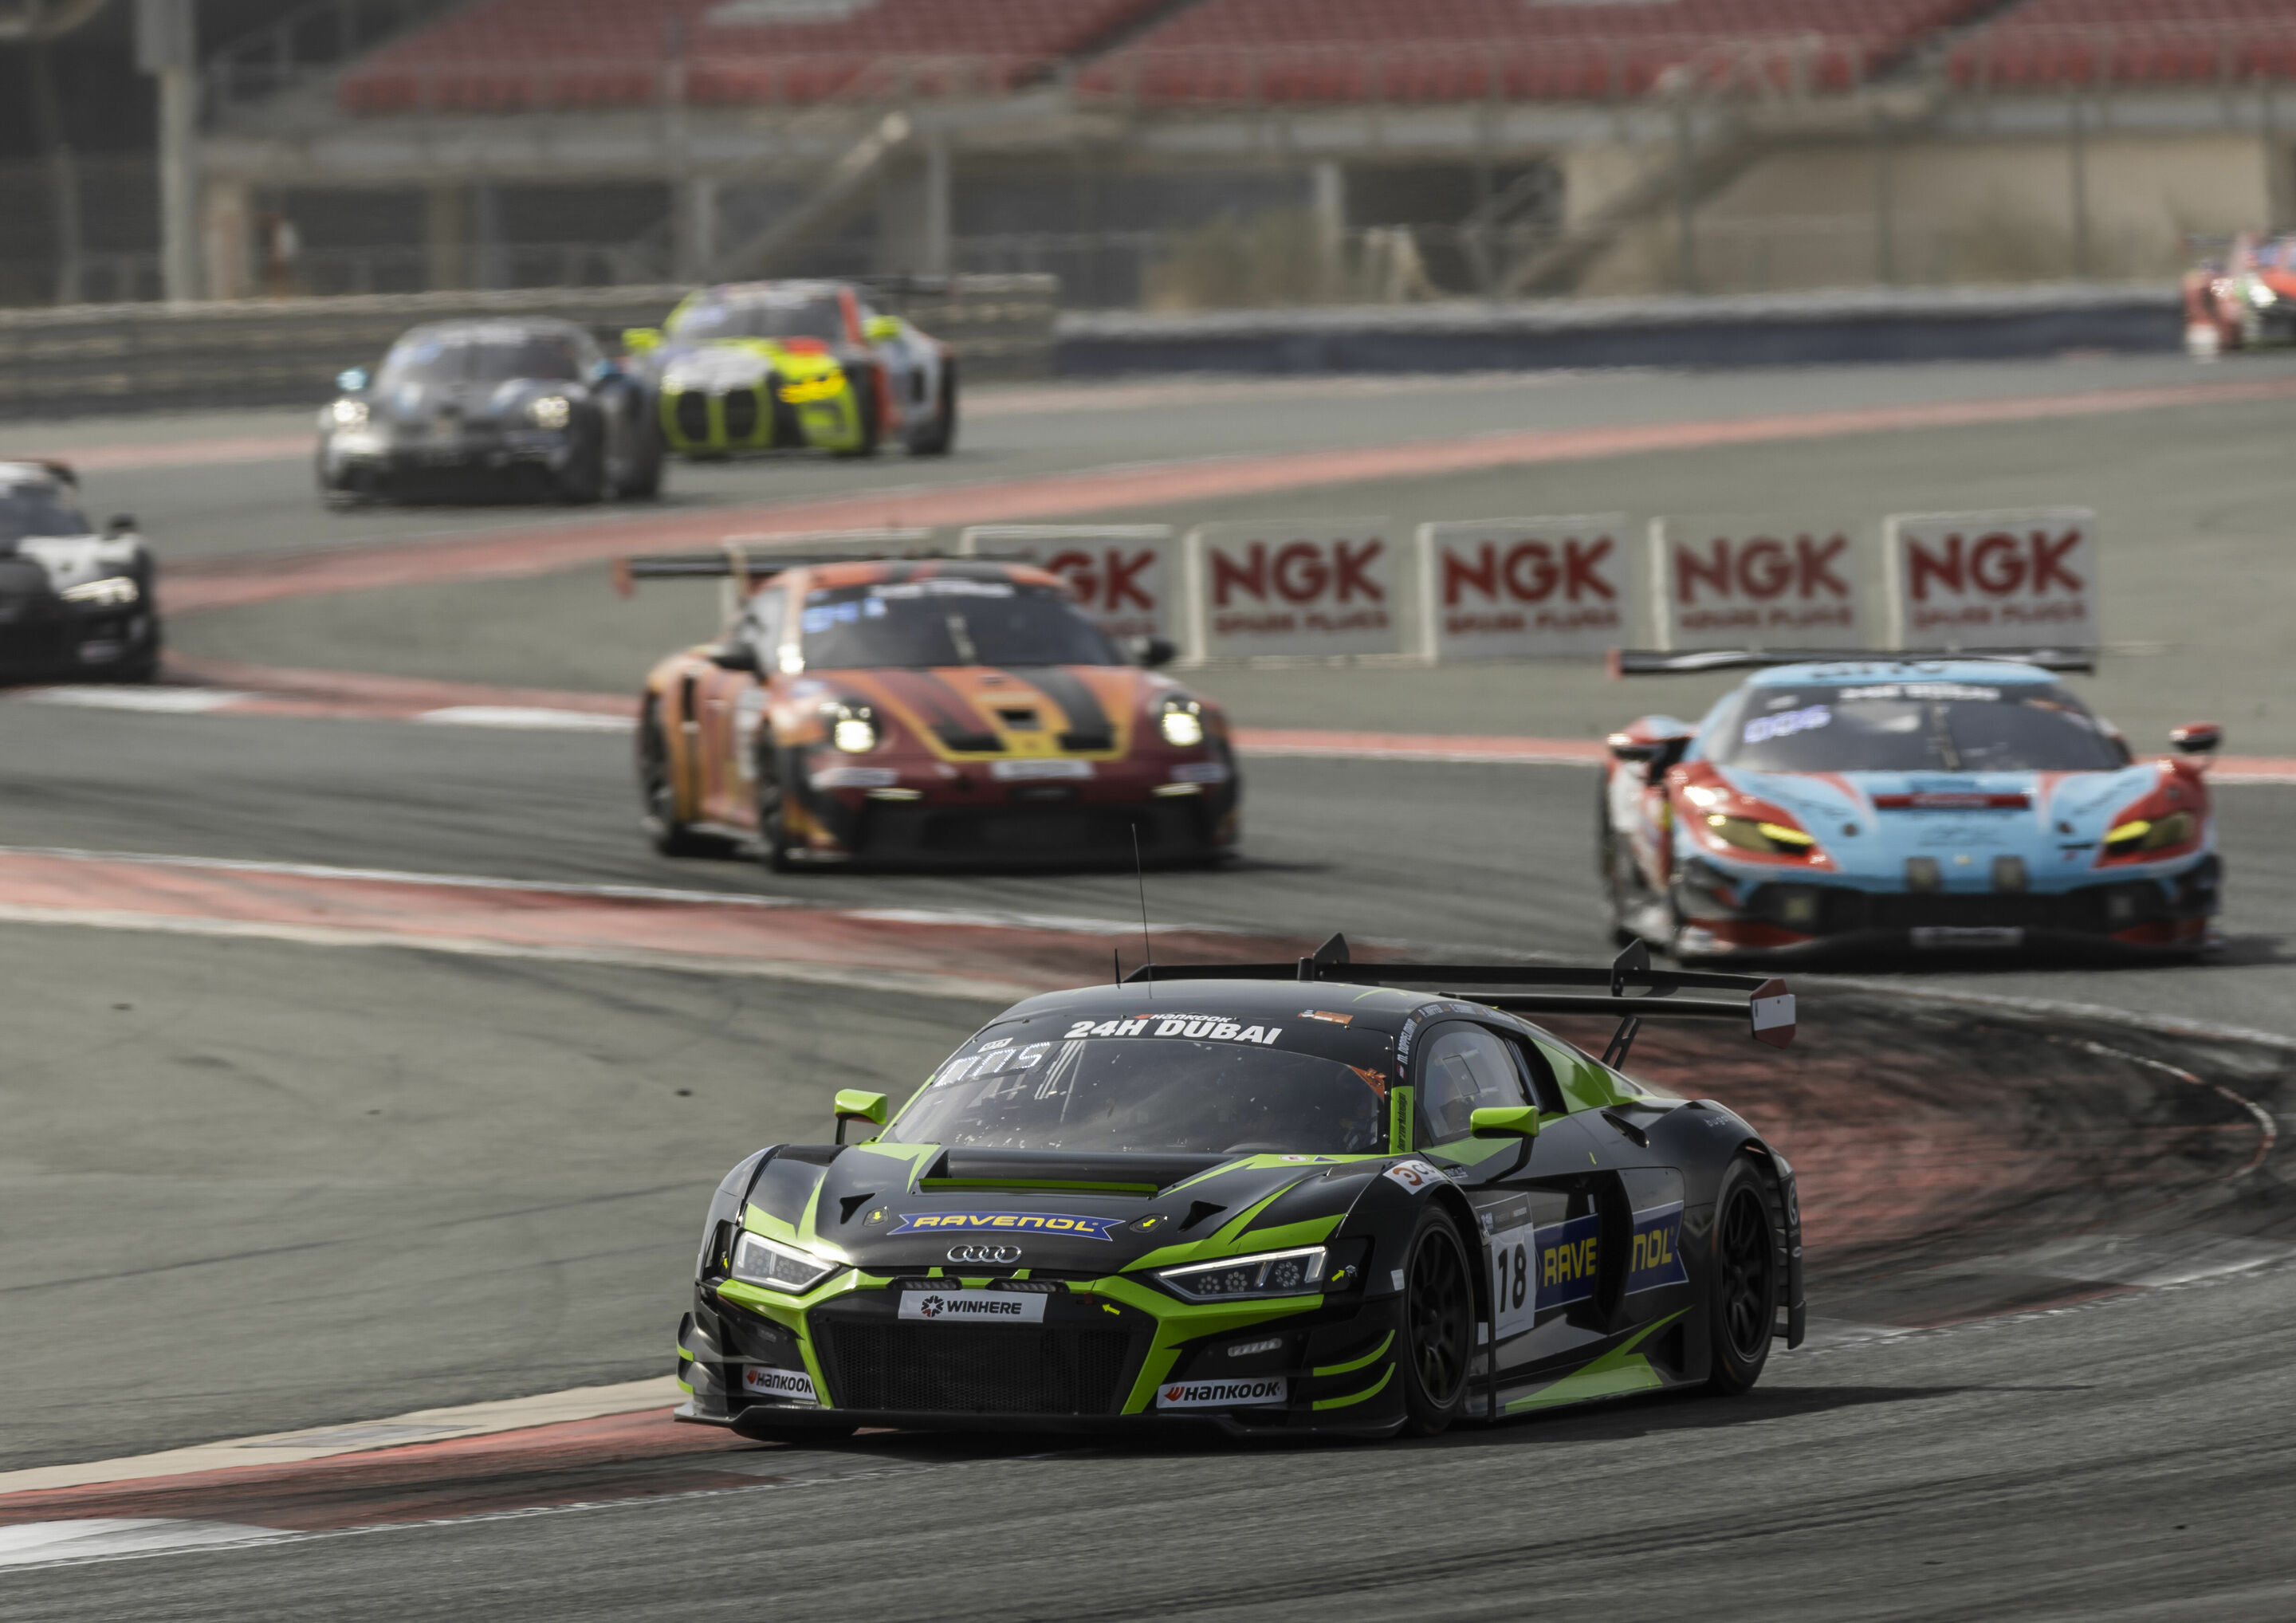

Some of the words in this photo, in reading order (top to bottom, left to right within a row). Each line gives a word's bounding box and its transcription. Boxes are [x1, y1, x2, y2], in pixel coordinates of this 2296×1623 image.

[1041, 547, 1155, 612] GK
[1211, 538, 1385, 607] NGK
[1441, 536, 1615, 607] NGK
[1676, 533, 1847, 603] NGK
[1906, 528, 2082, 600] NGK
[1063, 1020, 1149, 1039] 24H
[1154, 1020, 1283, 1045] DUBAI
[913, 1215, 1096, 1232] RAVENOL
[947, 1300, 1022, 1315] WINHERE
[1498, 1244, 1527, 1314] 18
